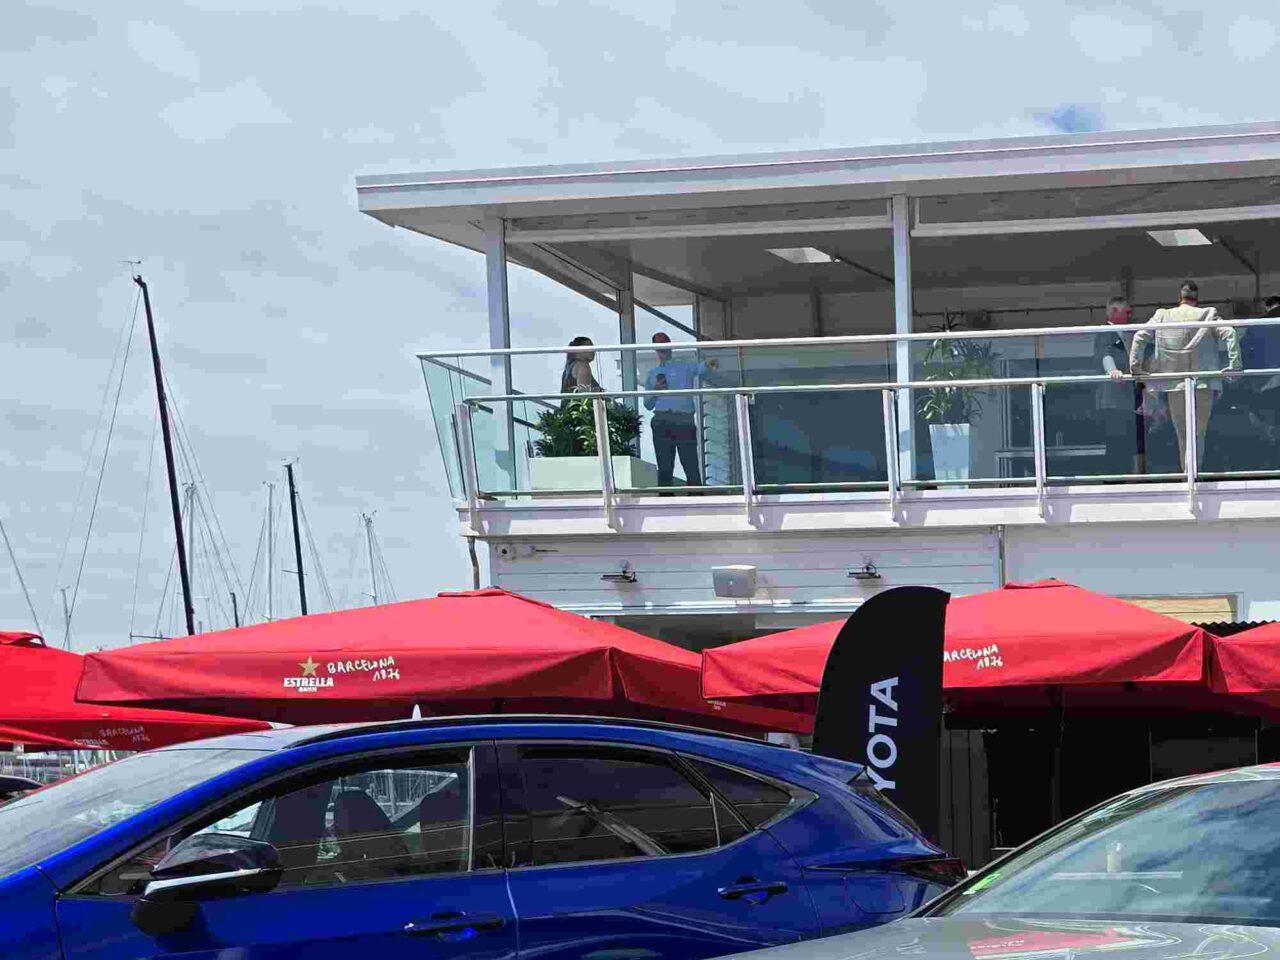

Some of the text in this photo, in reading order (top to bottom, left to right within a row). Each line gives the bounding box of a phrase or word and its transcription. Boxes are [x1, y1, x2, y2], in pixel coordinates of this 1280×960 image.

[943, 644, 998, 663] ARCELONA
[327, 655, 395, 674] BARCELONA
[283, 677, 334, 687] ESTRELLA
[373, 668, 400, 682] 1876
[866, 676, 899, 791] YOTA
